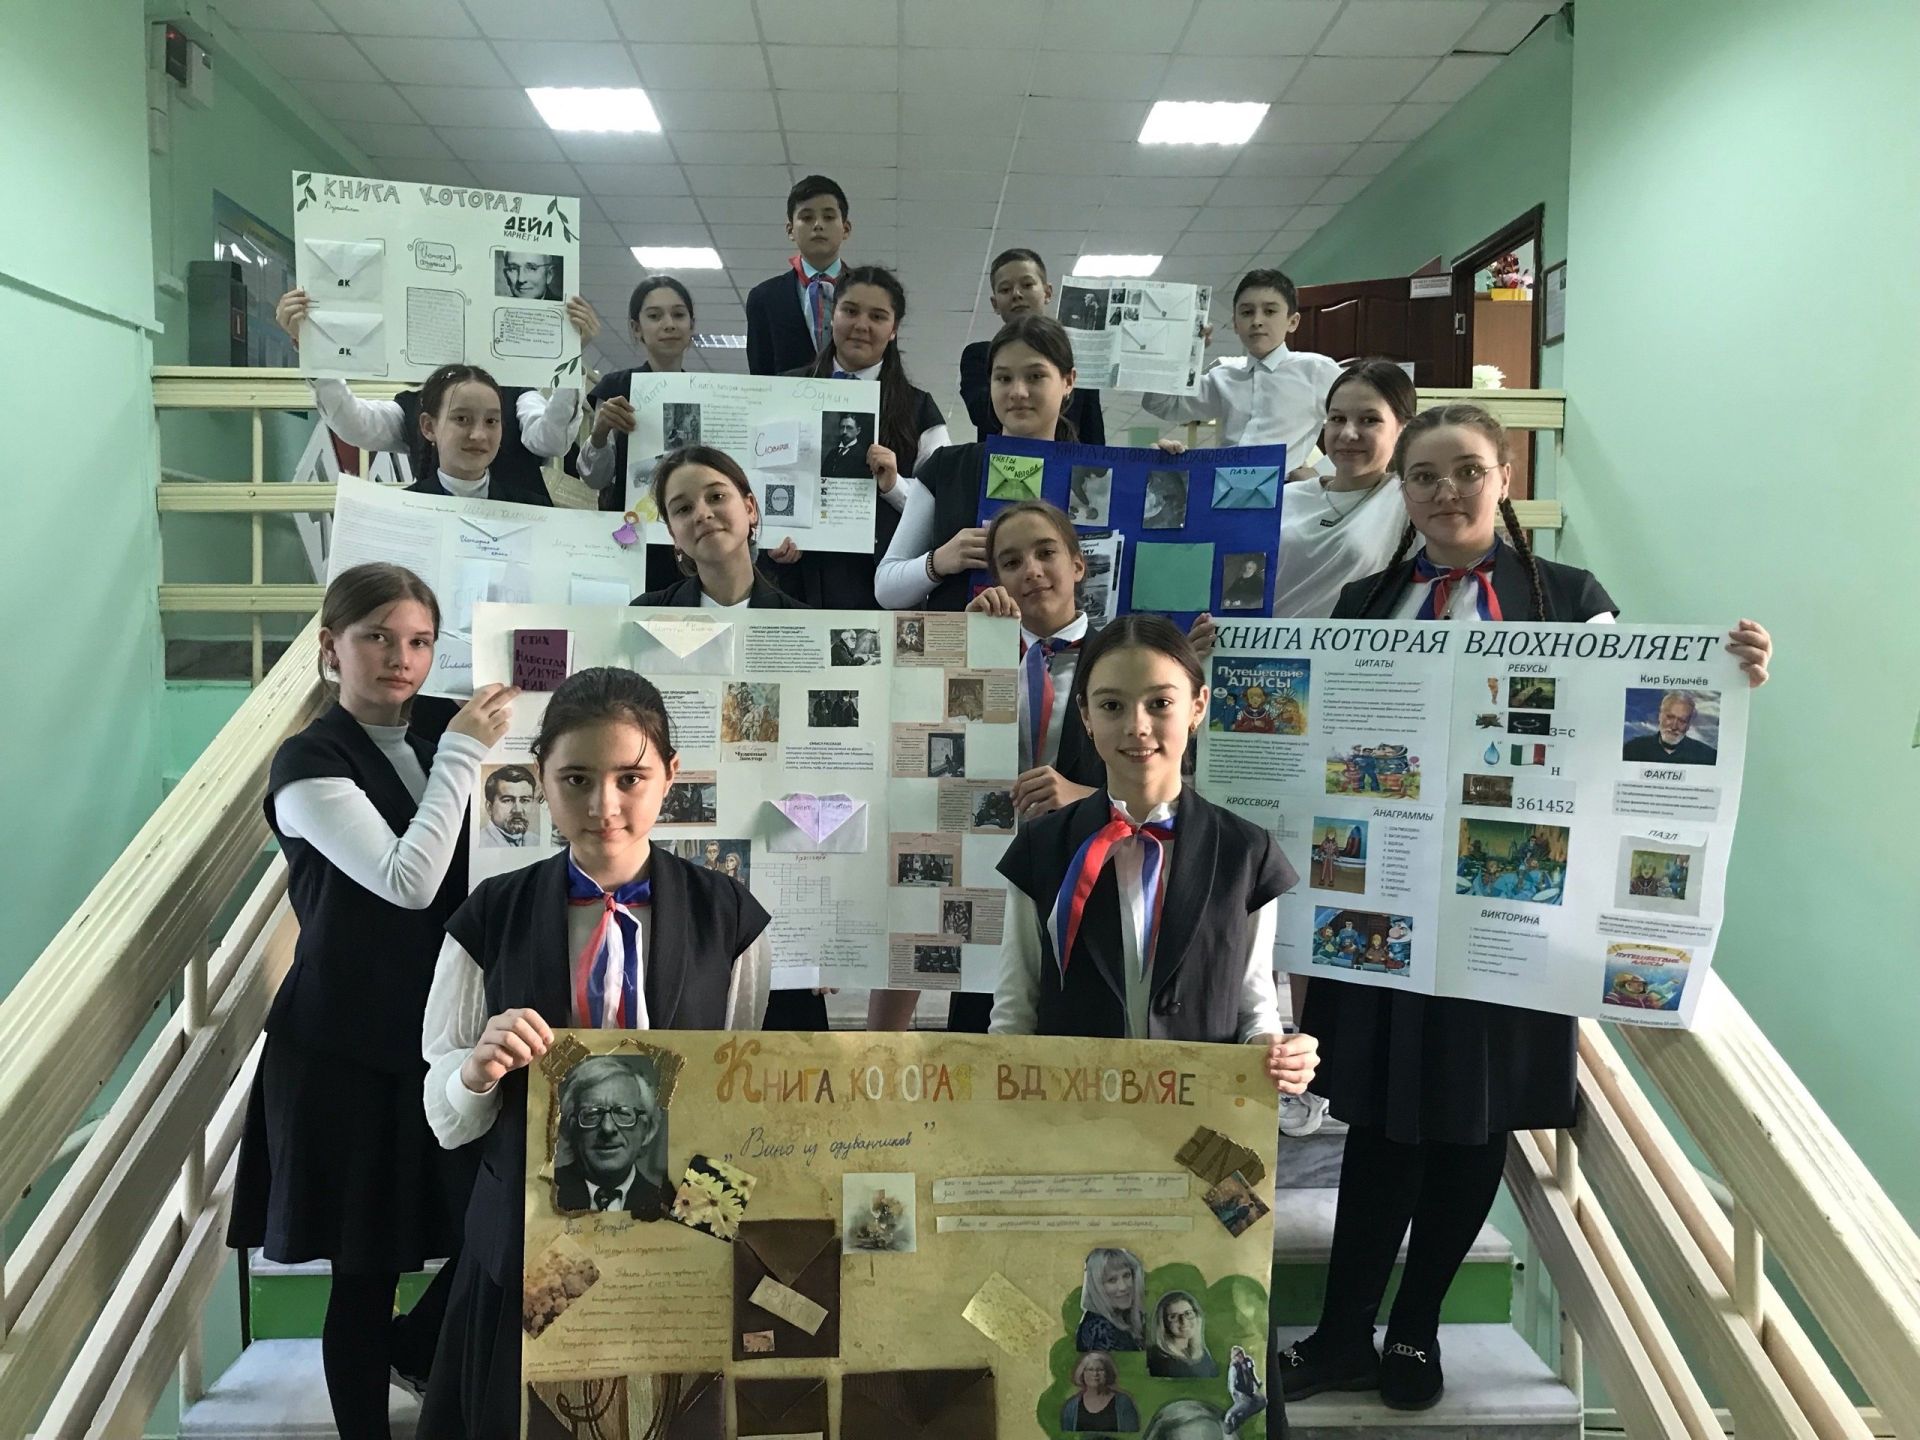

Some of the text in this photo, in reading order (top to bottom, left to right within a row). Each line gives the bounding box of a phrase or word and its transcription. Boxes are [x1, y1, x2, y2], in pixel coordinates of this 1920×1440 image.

[324, 177, 523, 214] КНИГА КОТОРАЯ
[504, 216, 553, 238] ДЕЙЛ
[792, 380, 849, 411] Бунин
[520, 635, 550, 646] СТИХ
[1211, 626, 1719, 662] КНИГА КОТОРАЯ ВДОХНОВЛЯЕТ
[1355, 658, 1394, 669] ЦИТАТЫ
[1507, 663, 1547, 673] РЕБУСЫ
[1217, 666, 1304, 678] Путешествие
[1227, 676, 1292, 689] АЛИСЫ
[1640, 674, 1709, 687] Кир Булычёв
[1644, 769, 1683, 781] ФАКТЫ
[1226, 796, 1279, 809] КРОССВОРД
[1516, 797, 1574, 814] 361452
[1373, 808, 1434, 821] АНАГРАММЫ
[1648, 830, 1678, 841] ПАЗЛ
[1480, 909, 1540, 925] ВИКТОРИНА
